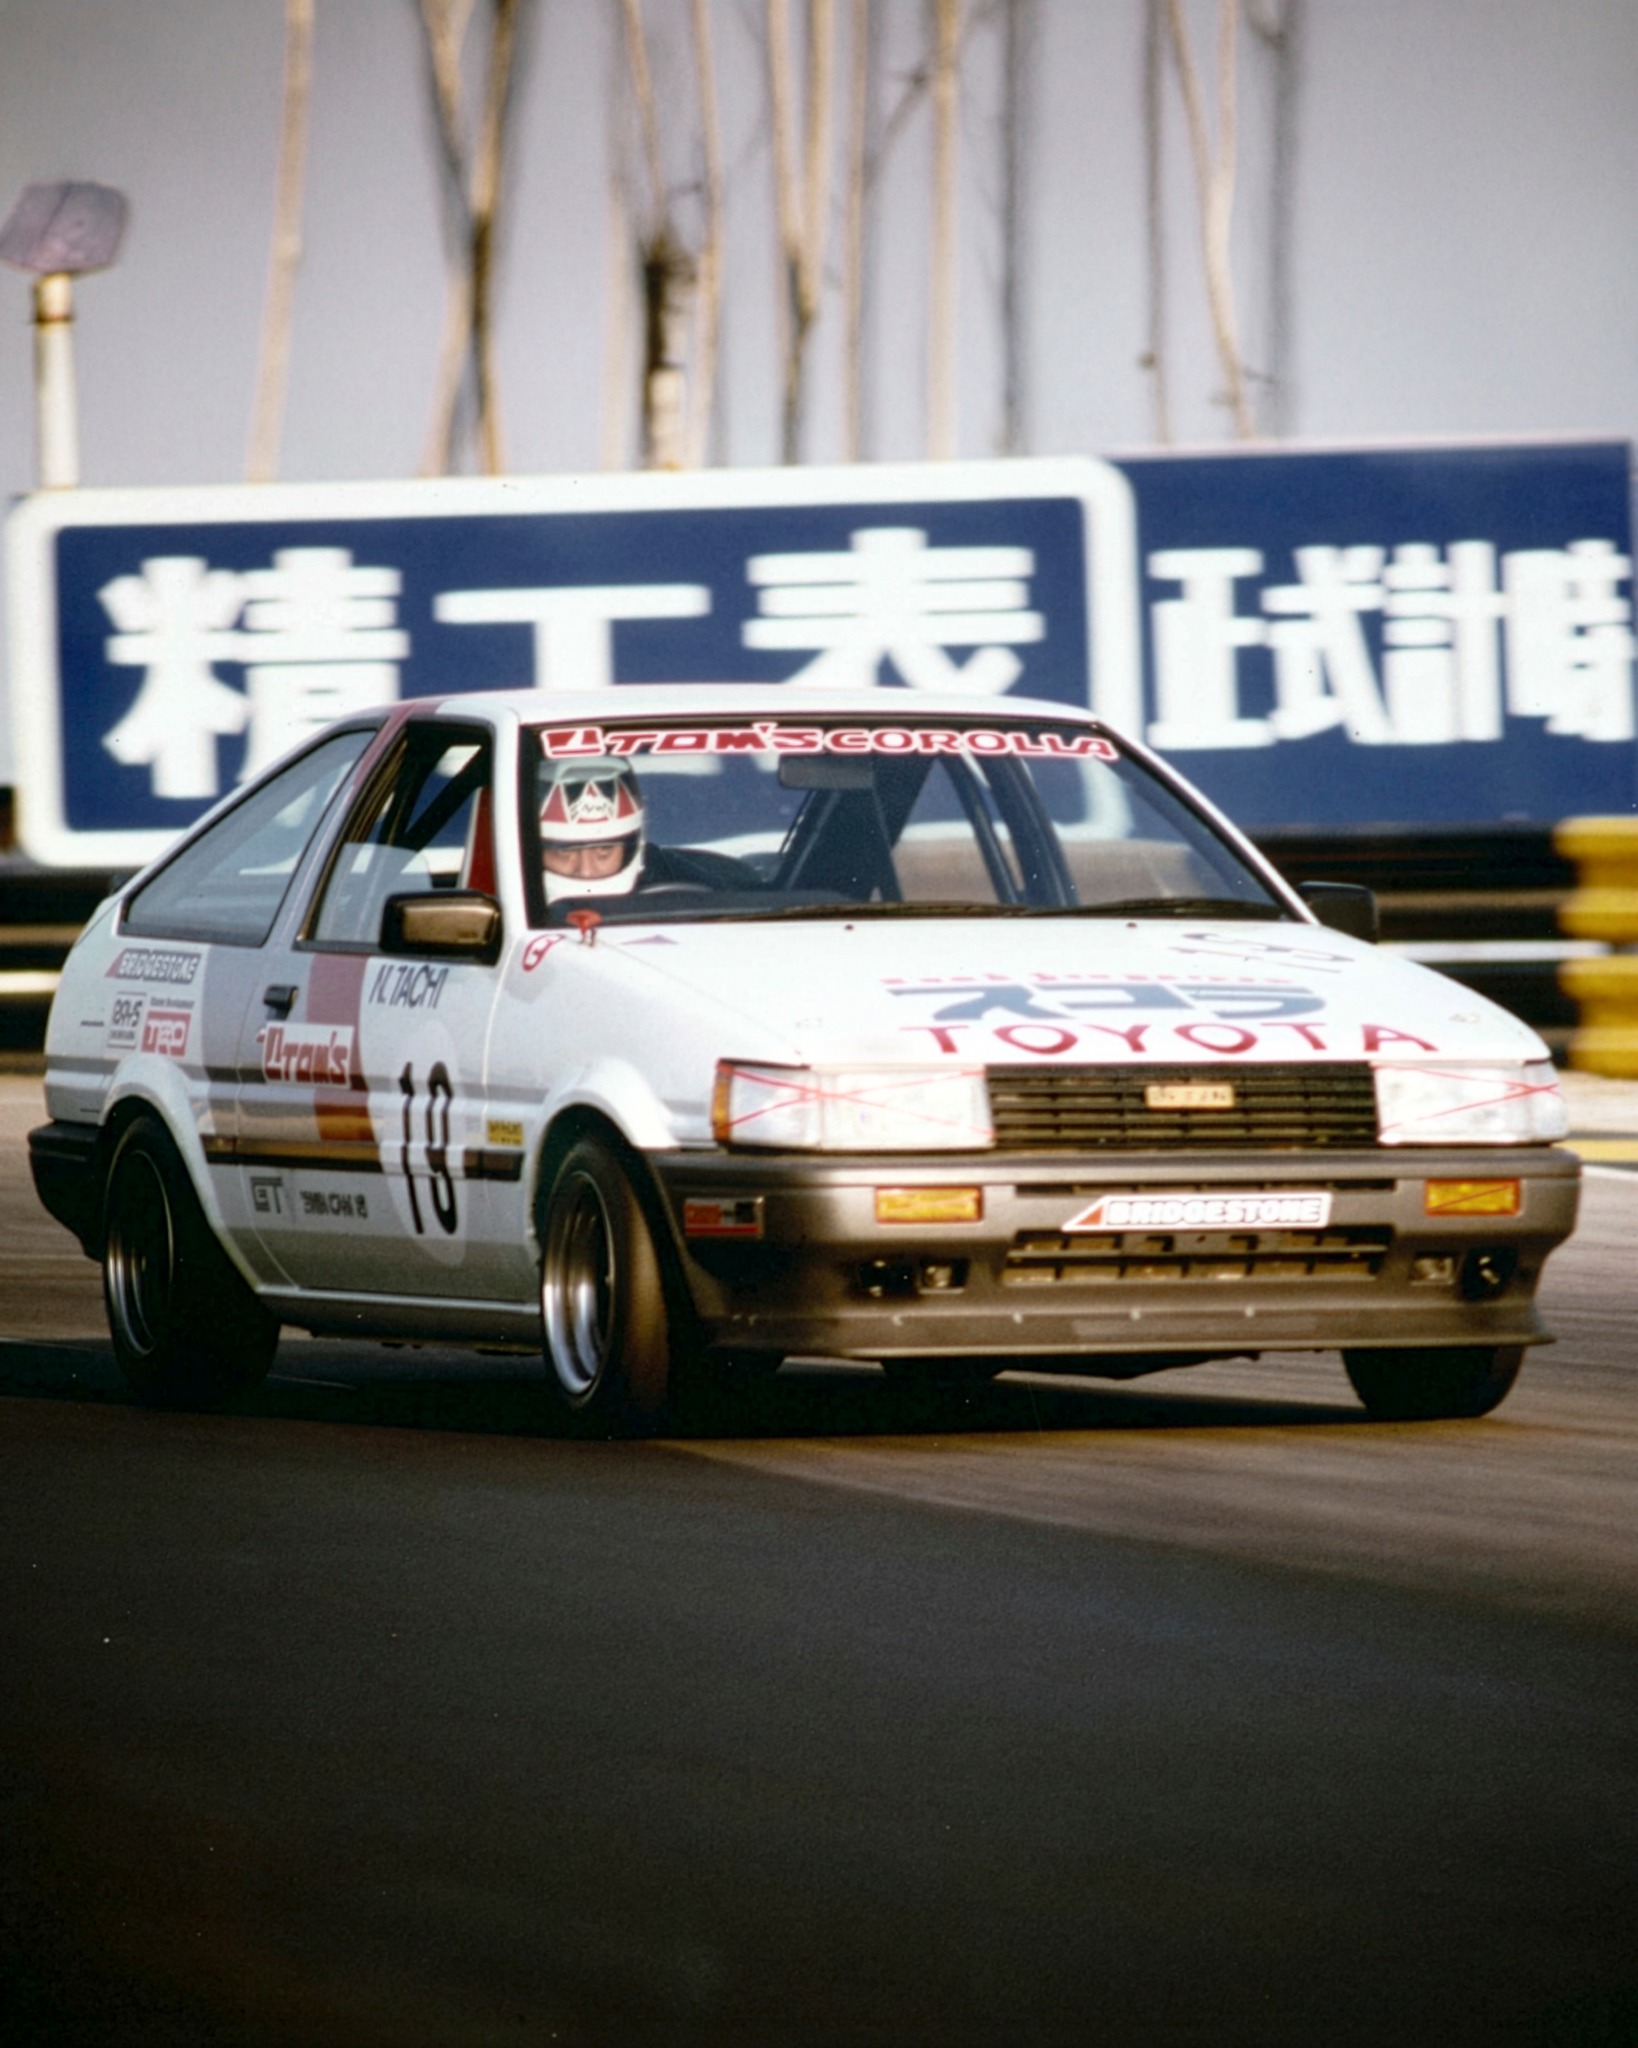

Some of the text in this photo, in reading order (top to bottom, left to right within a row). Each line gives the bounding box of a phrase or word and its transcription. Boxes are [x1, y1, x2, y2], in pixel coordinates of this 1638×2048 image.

[605, 723, 1118, 760] TOM'S COROLLA
[118, 951, 200, 982] BRIDGESTONE
[900, 1022, 1438, 1055] TOYOTA
[1106, 1197, 1322, 1226] BRIDGESTONE
